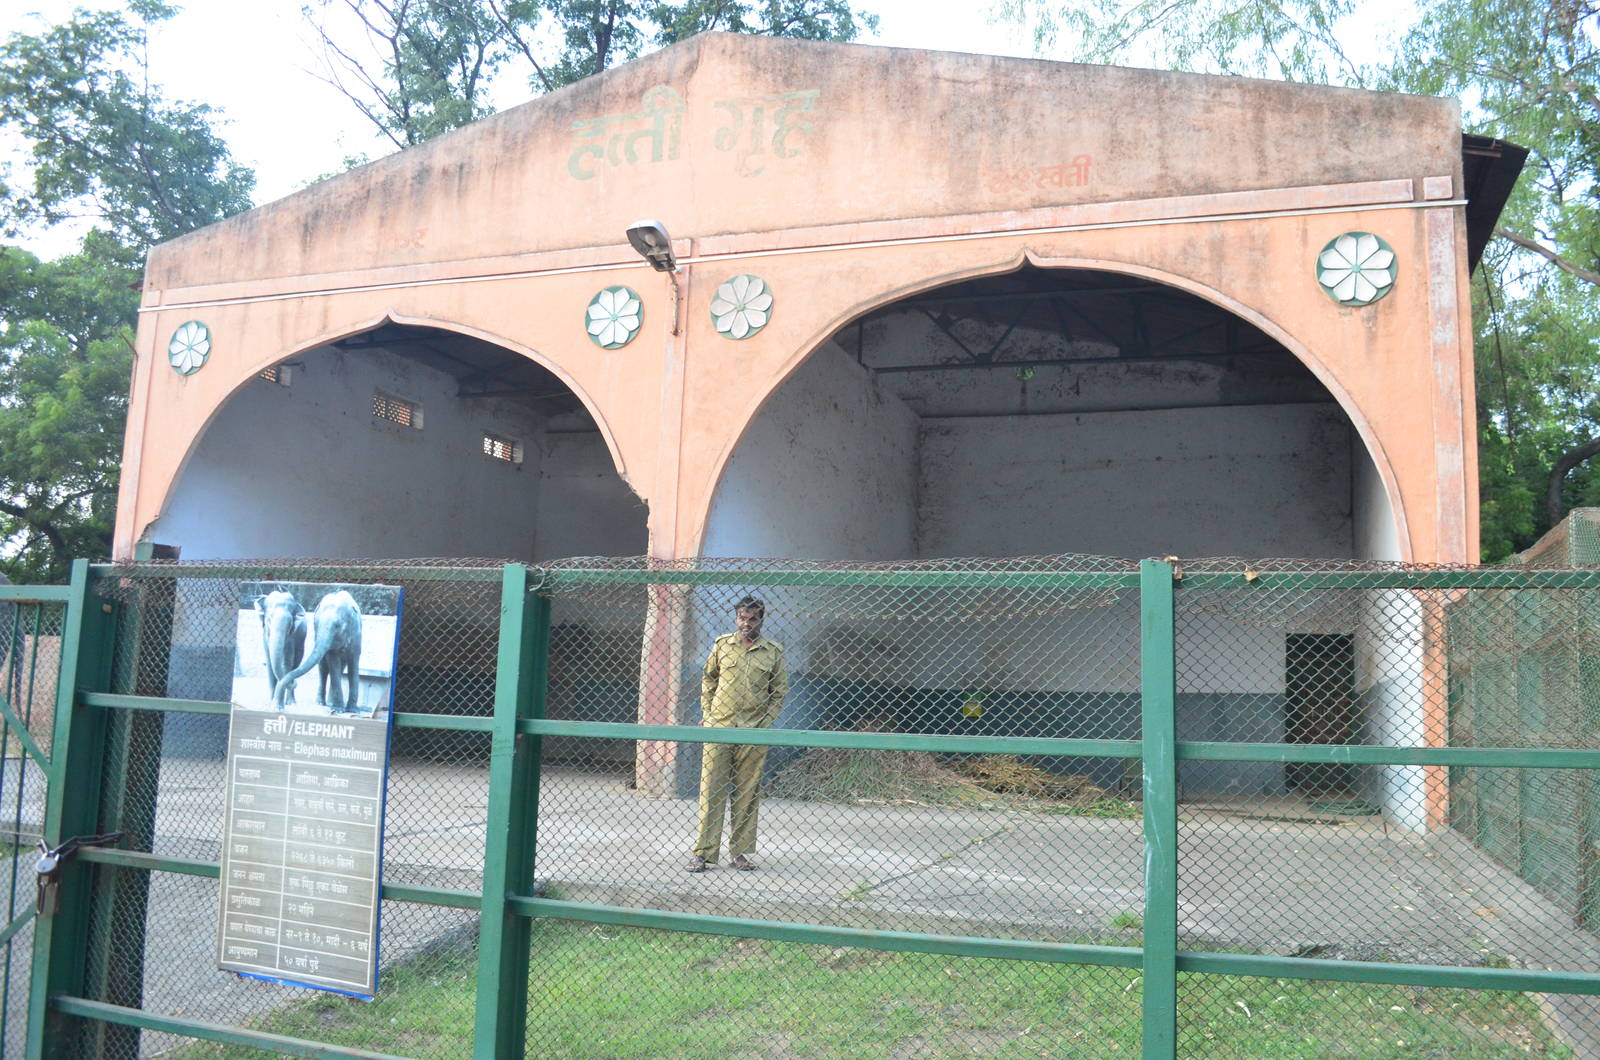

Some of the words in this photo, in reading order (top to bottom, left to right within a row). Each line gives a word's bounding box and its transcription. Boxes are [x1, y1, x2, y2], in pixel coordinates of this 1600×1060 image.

[263, 715, 287, 734] हत्ती
[294, 742, 330, 759] Elephas
[332, 747, 377, 762] maximum
